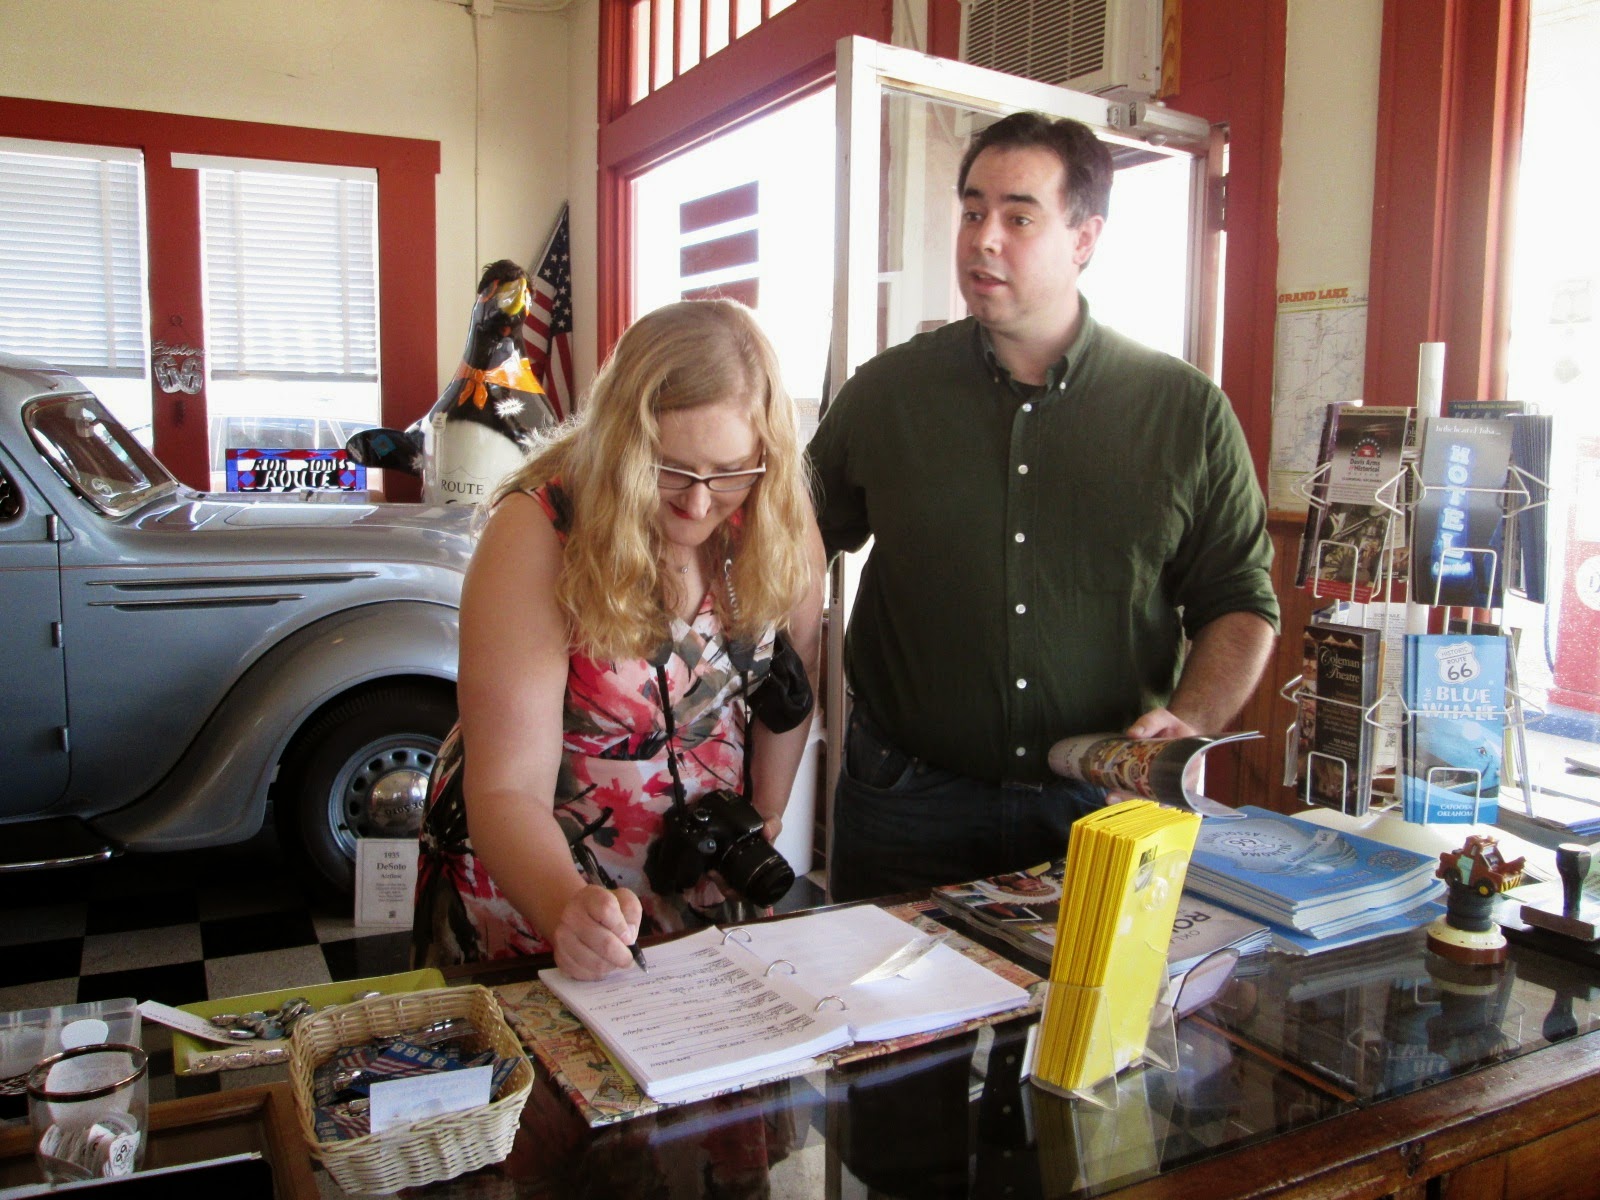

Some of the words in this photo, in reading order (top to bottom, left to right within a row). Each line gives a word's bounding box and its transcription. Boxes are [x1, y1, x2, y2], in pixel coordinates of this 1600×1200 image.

[1279, 291, 1316, 303] GRAND
[1319, 288, 1348, 299] LAKE
[154, 356, 204, 394] 66
[262, 470, 333, 487] ROUTE
[441, 480, 484, 495] ROUTE
[1319, 645, 1360, 669] Coleman
[1447, 656, 1467, 665] ROUTE
[1326, 665, 1360, 684] Theatre
[1447, 663, 1473, 681] 66
[1436, 685, 1491, 704] BLUE
[1422, 702, 1498, 721] WHALE
[1229, 838, 1257, 847] 66
[383, 851, 400, 859] 1935
[376, 862, 407, 871] DeSoto
